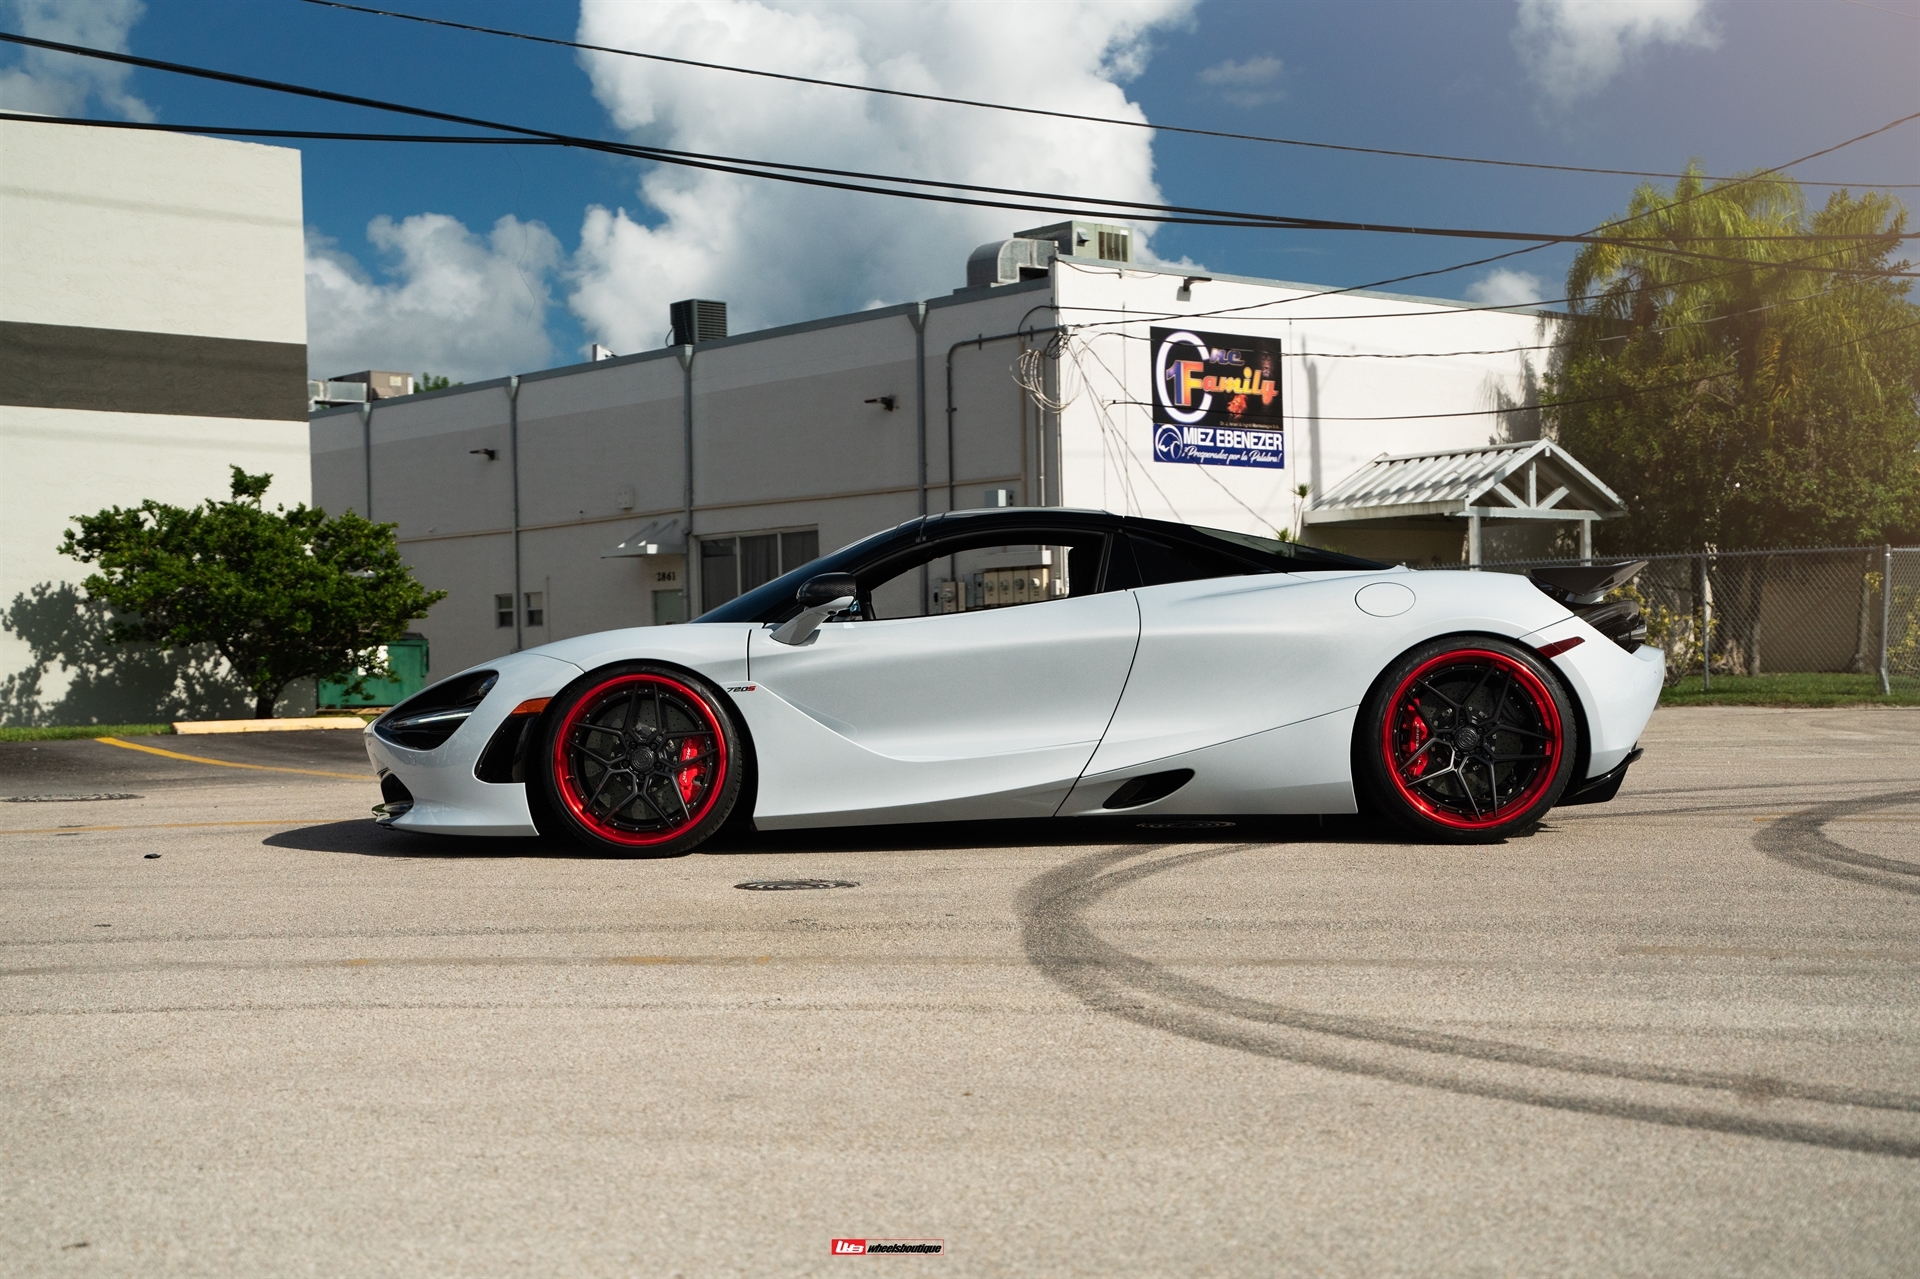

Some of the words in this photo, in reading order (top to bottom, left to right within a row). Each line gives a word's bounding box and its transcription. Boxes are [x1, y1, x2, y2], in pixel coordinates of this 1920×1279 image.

[1183, 426, 1214, 447] MIEZ
[1216, 429, 1283, 451] EBENEZER
[1226, 453, 1241, 465] por
[1240, 450, 1248, 461] la
[656, 571, 677, 582] 2861
[727, 685, 757, 693] 720S
